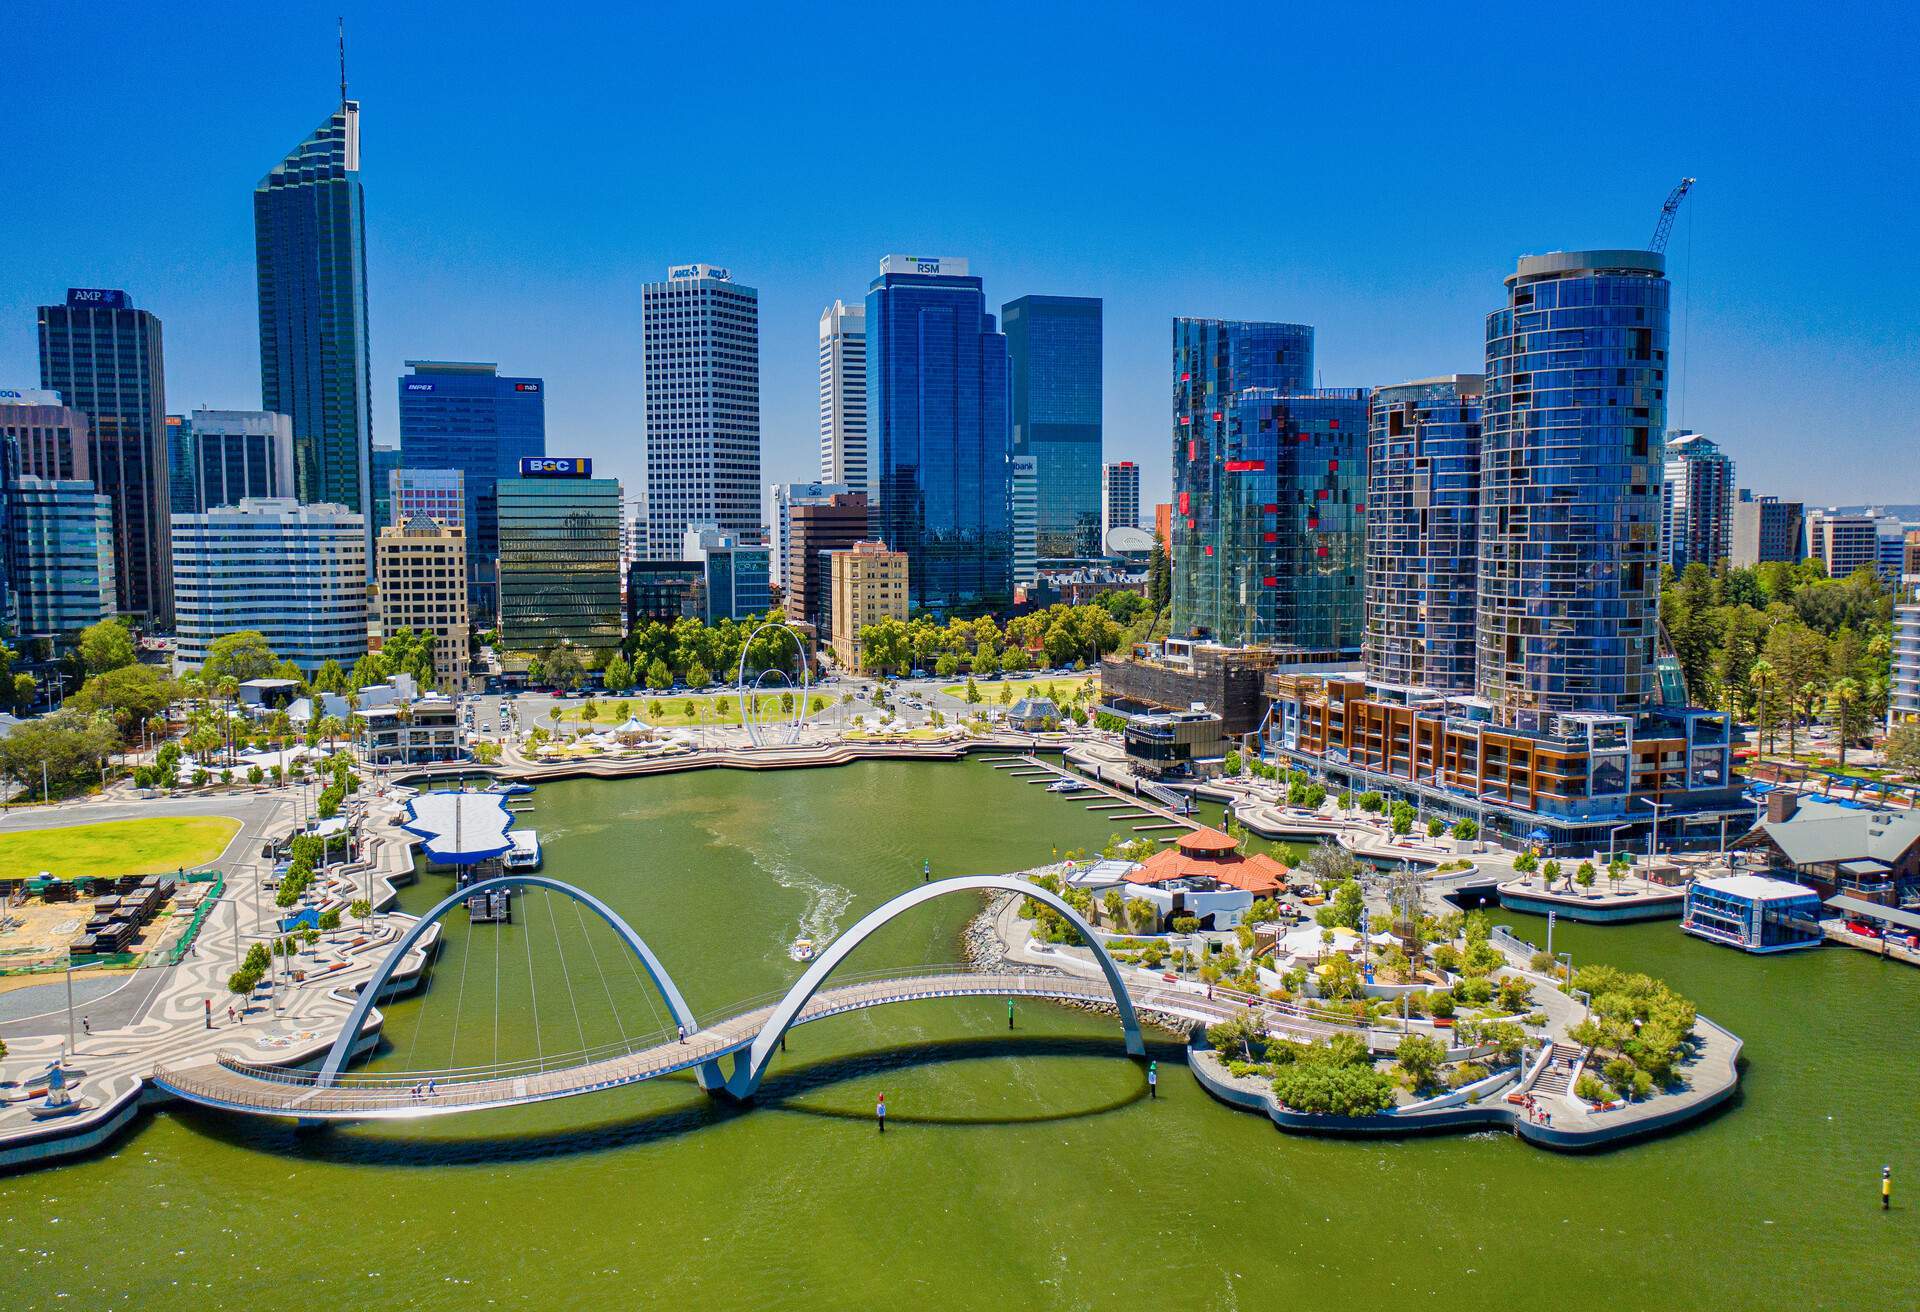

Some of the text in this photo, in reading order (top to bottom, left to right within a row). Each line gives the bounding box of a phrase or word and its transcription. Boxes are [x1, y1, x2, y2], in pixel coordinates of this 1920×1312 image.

[917, 264, 939, 273] RSM
[672, 269, 690, 278] ANZ
[75, 291, 101, 300] AMP
[530, 460, 570, 471] BGC
